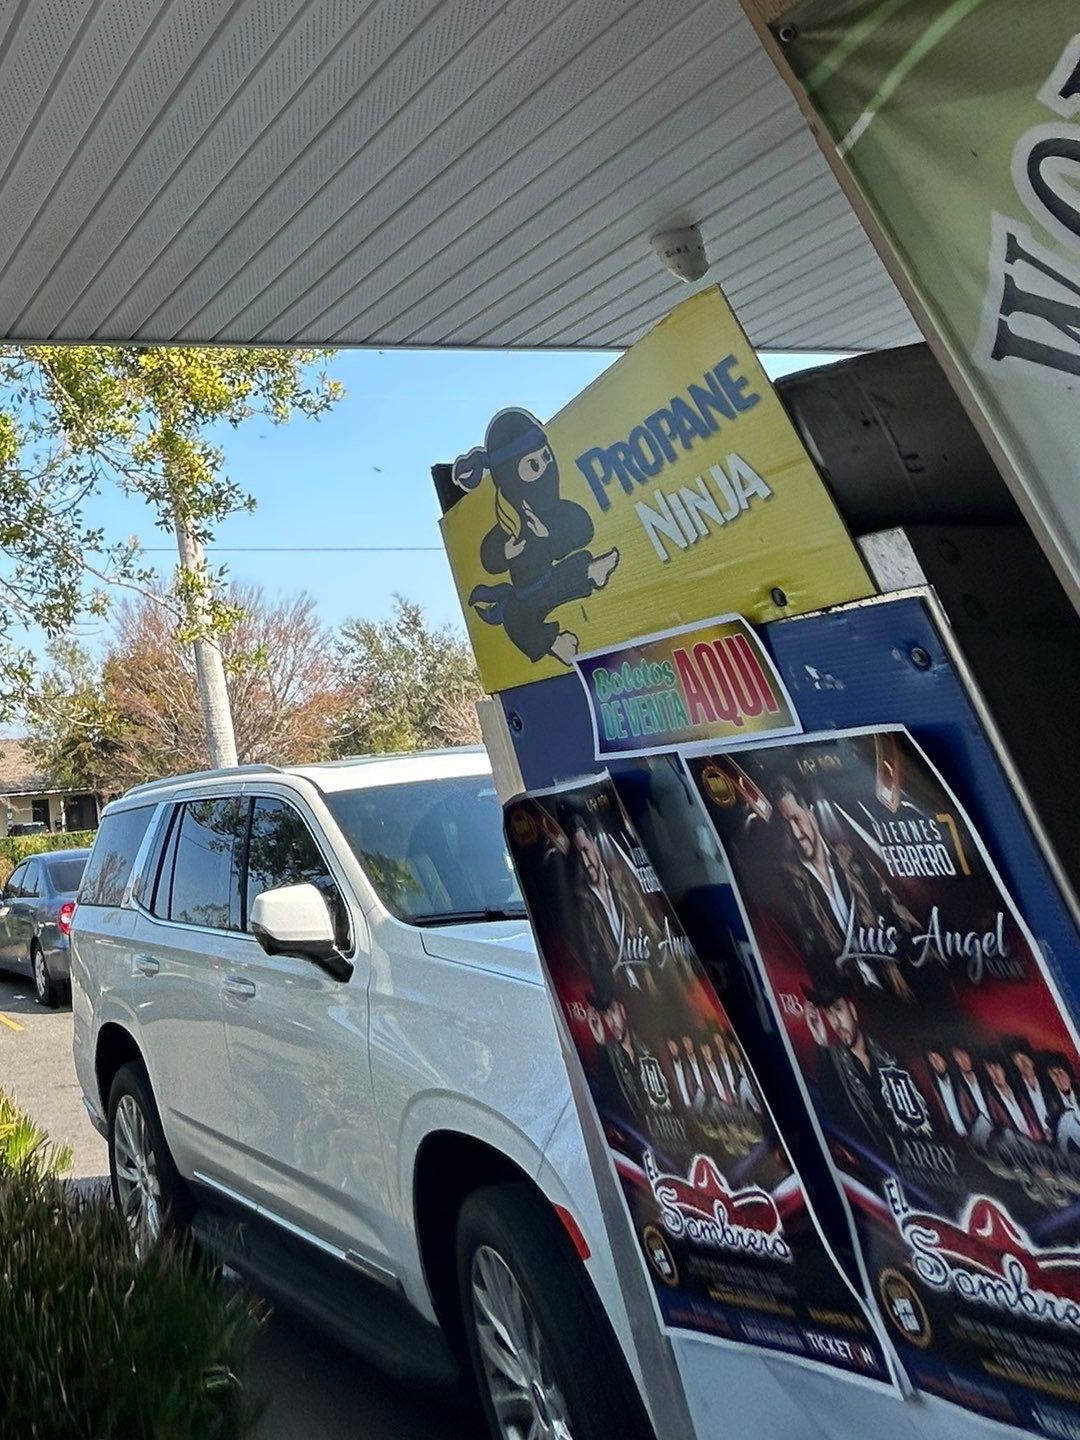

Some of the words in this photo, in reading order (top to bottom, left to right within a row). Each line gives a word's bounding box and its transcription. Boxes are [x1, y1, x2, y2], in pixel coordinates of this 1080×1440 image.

[575, 353, 761, 512] PROPANE
[635, 453, 773, 563] NINJA
[592, 659, 676, 701] Boletos
[672, 633, 779, 727] AQUI
[600, 702, 628, 741] DE
[621, 689, 689, 737] VENTA
[872, 818, 941, 844] VIERNES
[881, 843, 956, 877] FEBRERO
[936, 812, 971, 876] 7
[835, 896, 899, 967] Luis
[908, 906, 1007, 984] Angel
[644, 1150, 659, 1181] EL
[885, 1180, 909, 1215] EL
[656, 1185, 792, 1262] Sombrero
[908, 1223, 1080, 1325] Sombre
